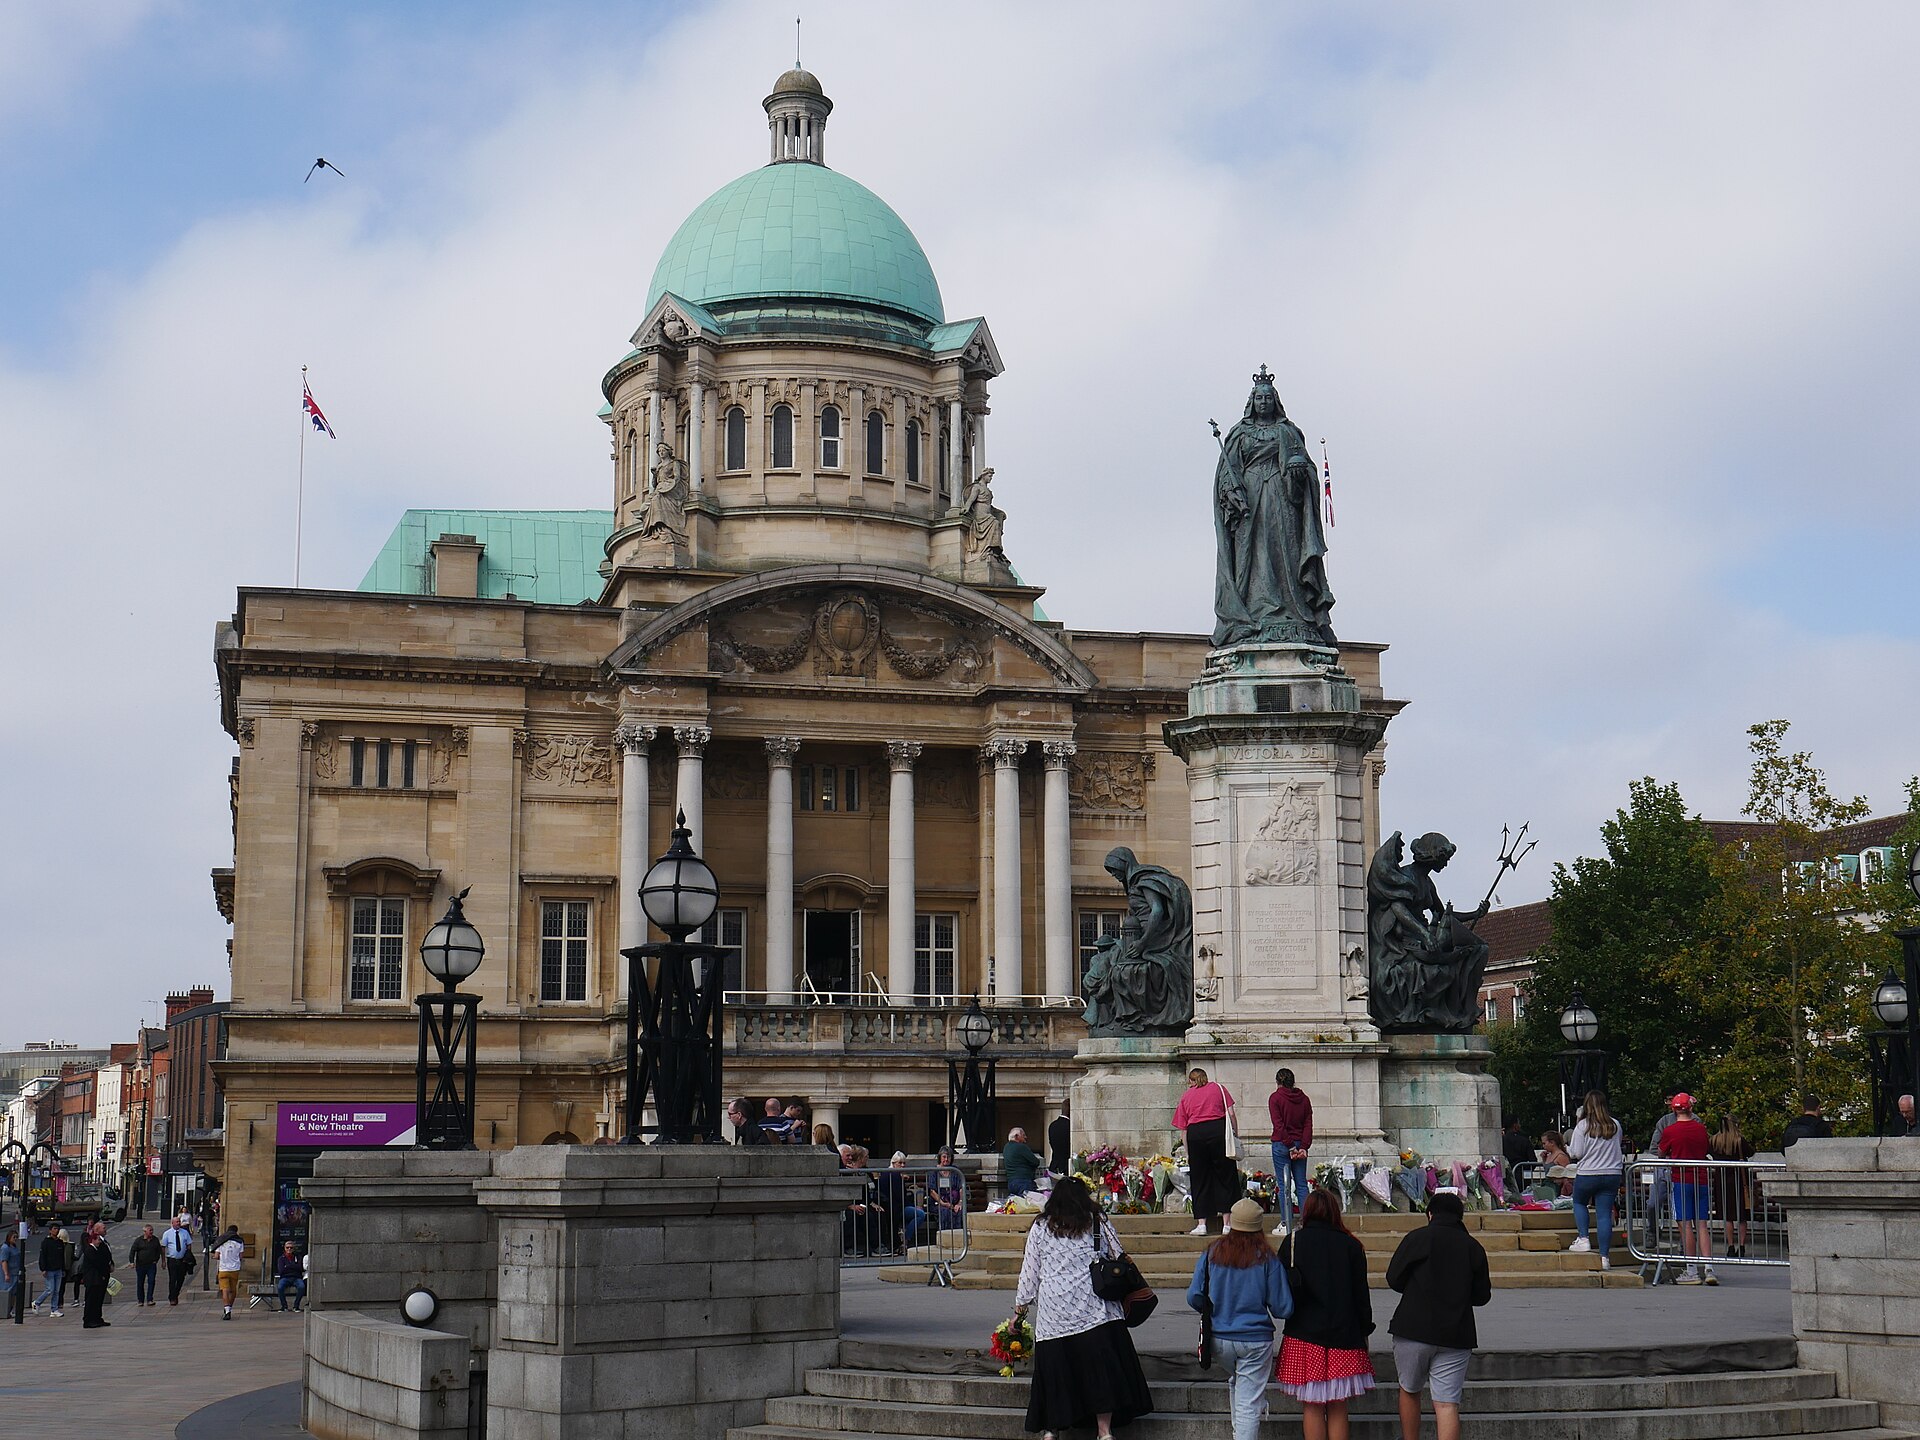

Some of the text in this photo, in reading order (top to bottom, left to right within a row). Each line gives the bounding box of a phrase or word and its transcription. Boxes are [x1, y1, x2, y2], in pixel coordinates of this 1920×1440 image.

[1228, 746, 1324, 760] VICTORIA DEI
[290, 1113, 348, 1123] Hull City Hall
[298, 1122, 364, 1131] & New Theatre
